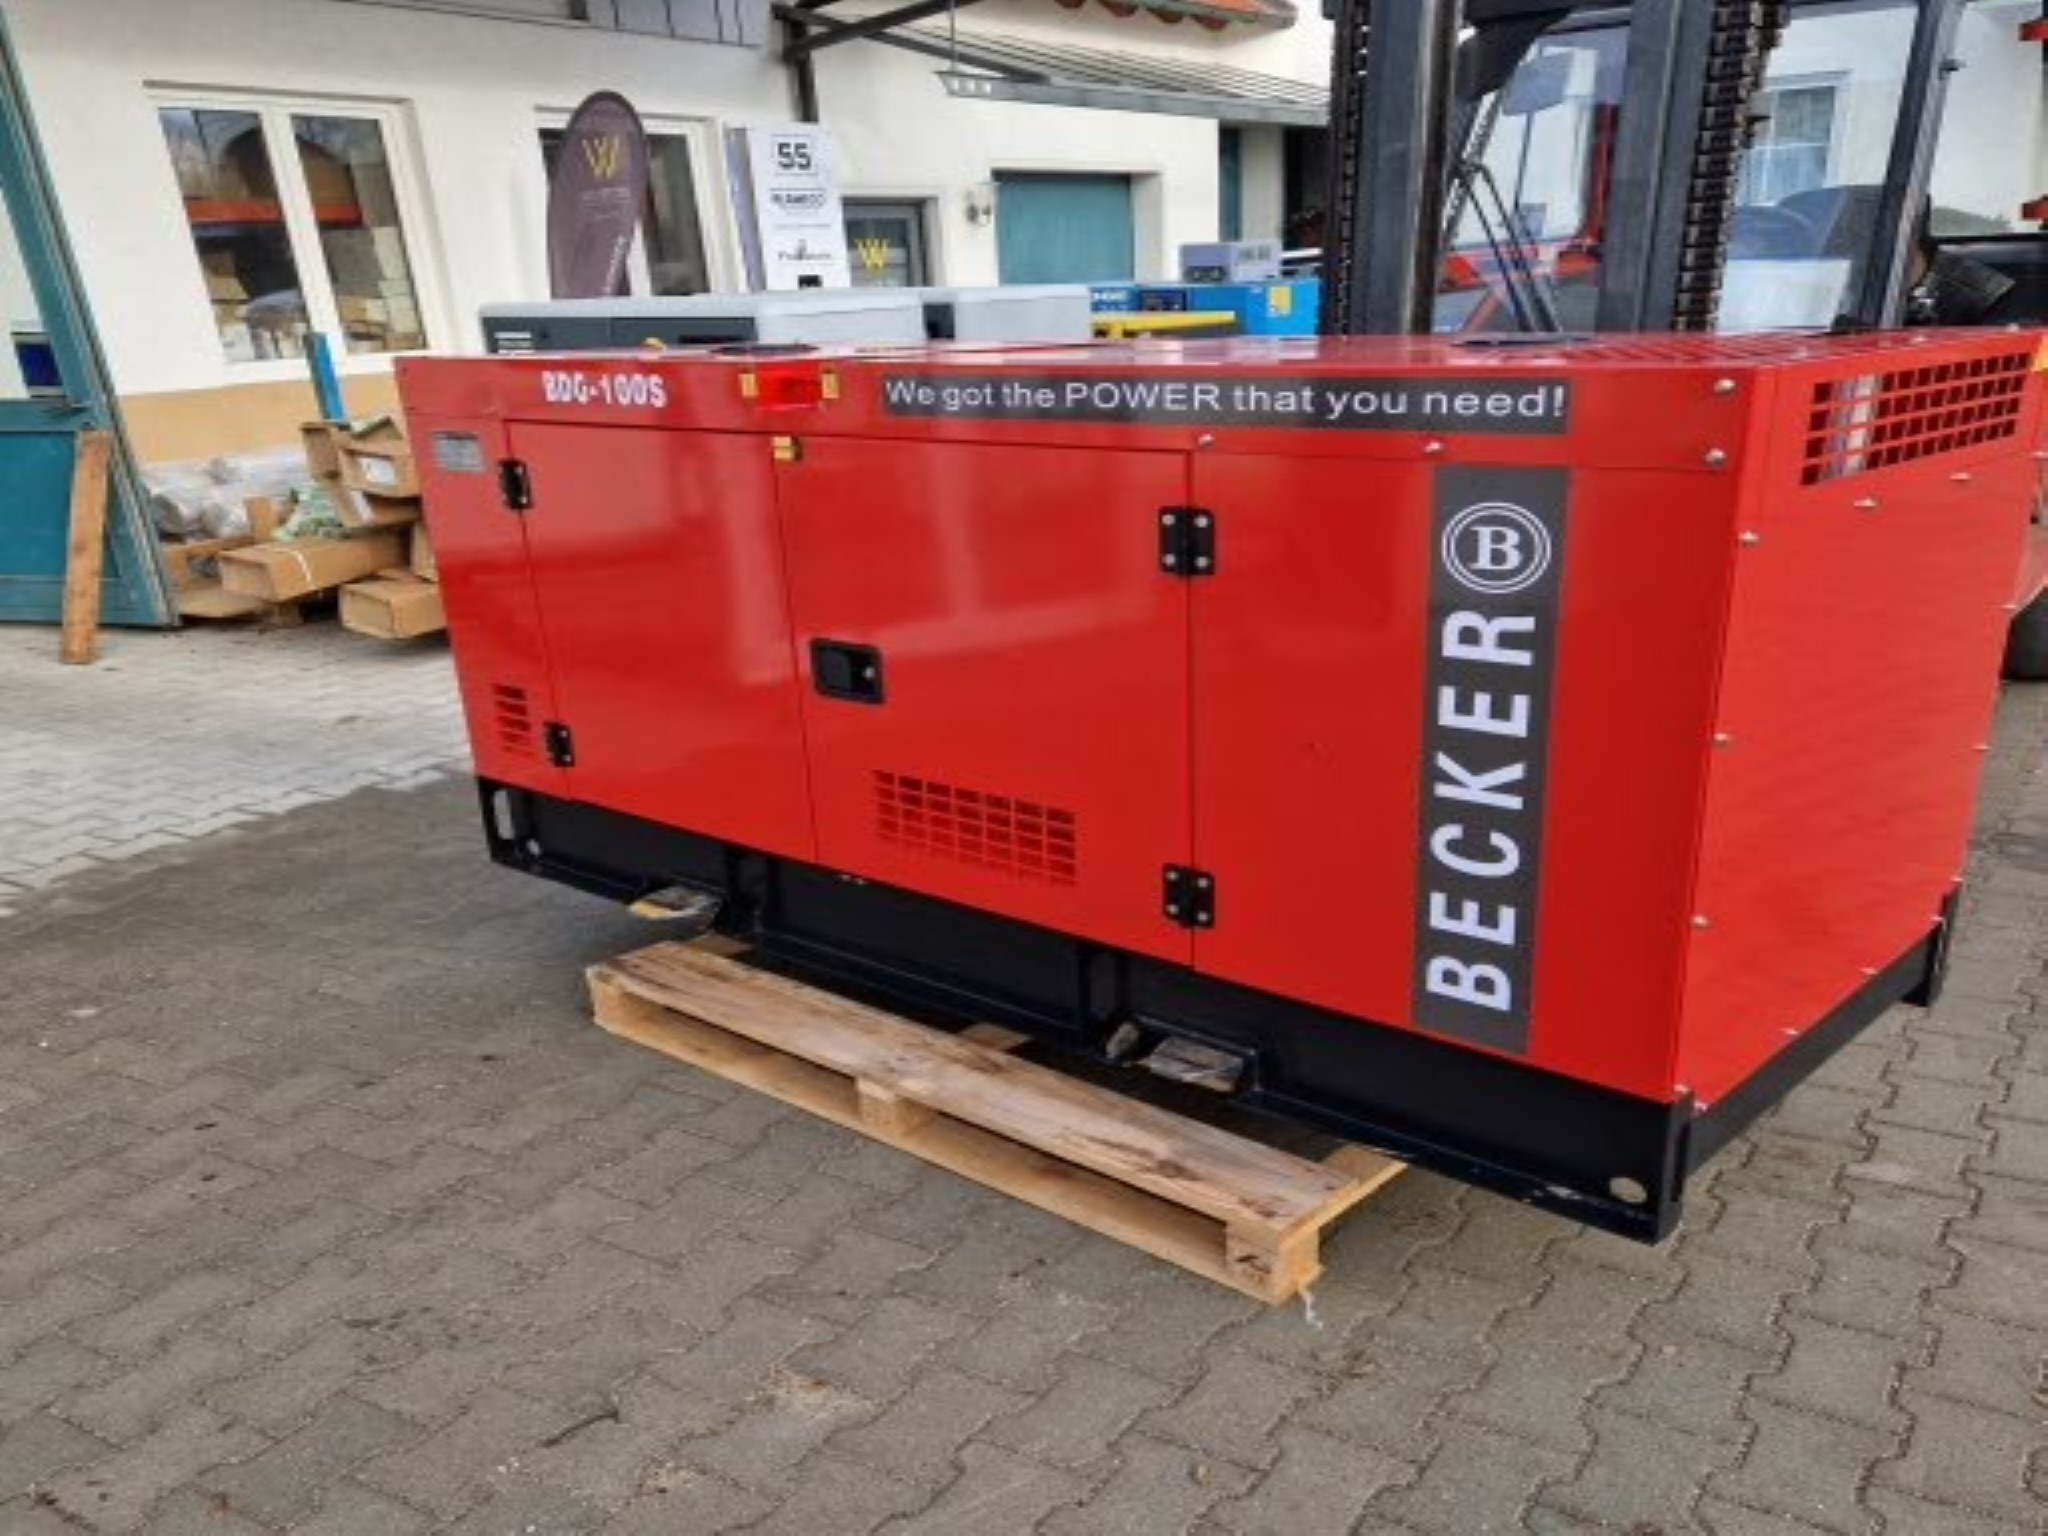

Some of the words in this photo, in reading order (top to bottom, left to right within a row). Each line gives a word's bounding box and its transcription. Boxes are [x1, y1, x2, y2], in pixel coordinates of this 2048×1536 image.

[885, 379, 935, 405] We
[942, 382, 993, 411] got
[1002, 381, 1056, 408] the
[1064, 382, 1220, 411] POWER
[1233, 385, 1316, 412] that
[1326, 390, 1407, 420] you
[1422, 385, 1566, 418] need!
[1469, 524, 1523, 571] B
[1425, 608, 1536, 1012] BECKER
